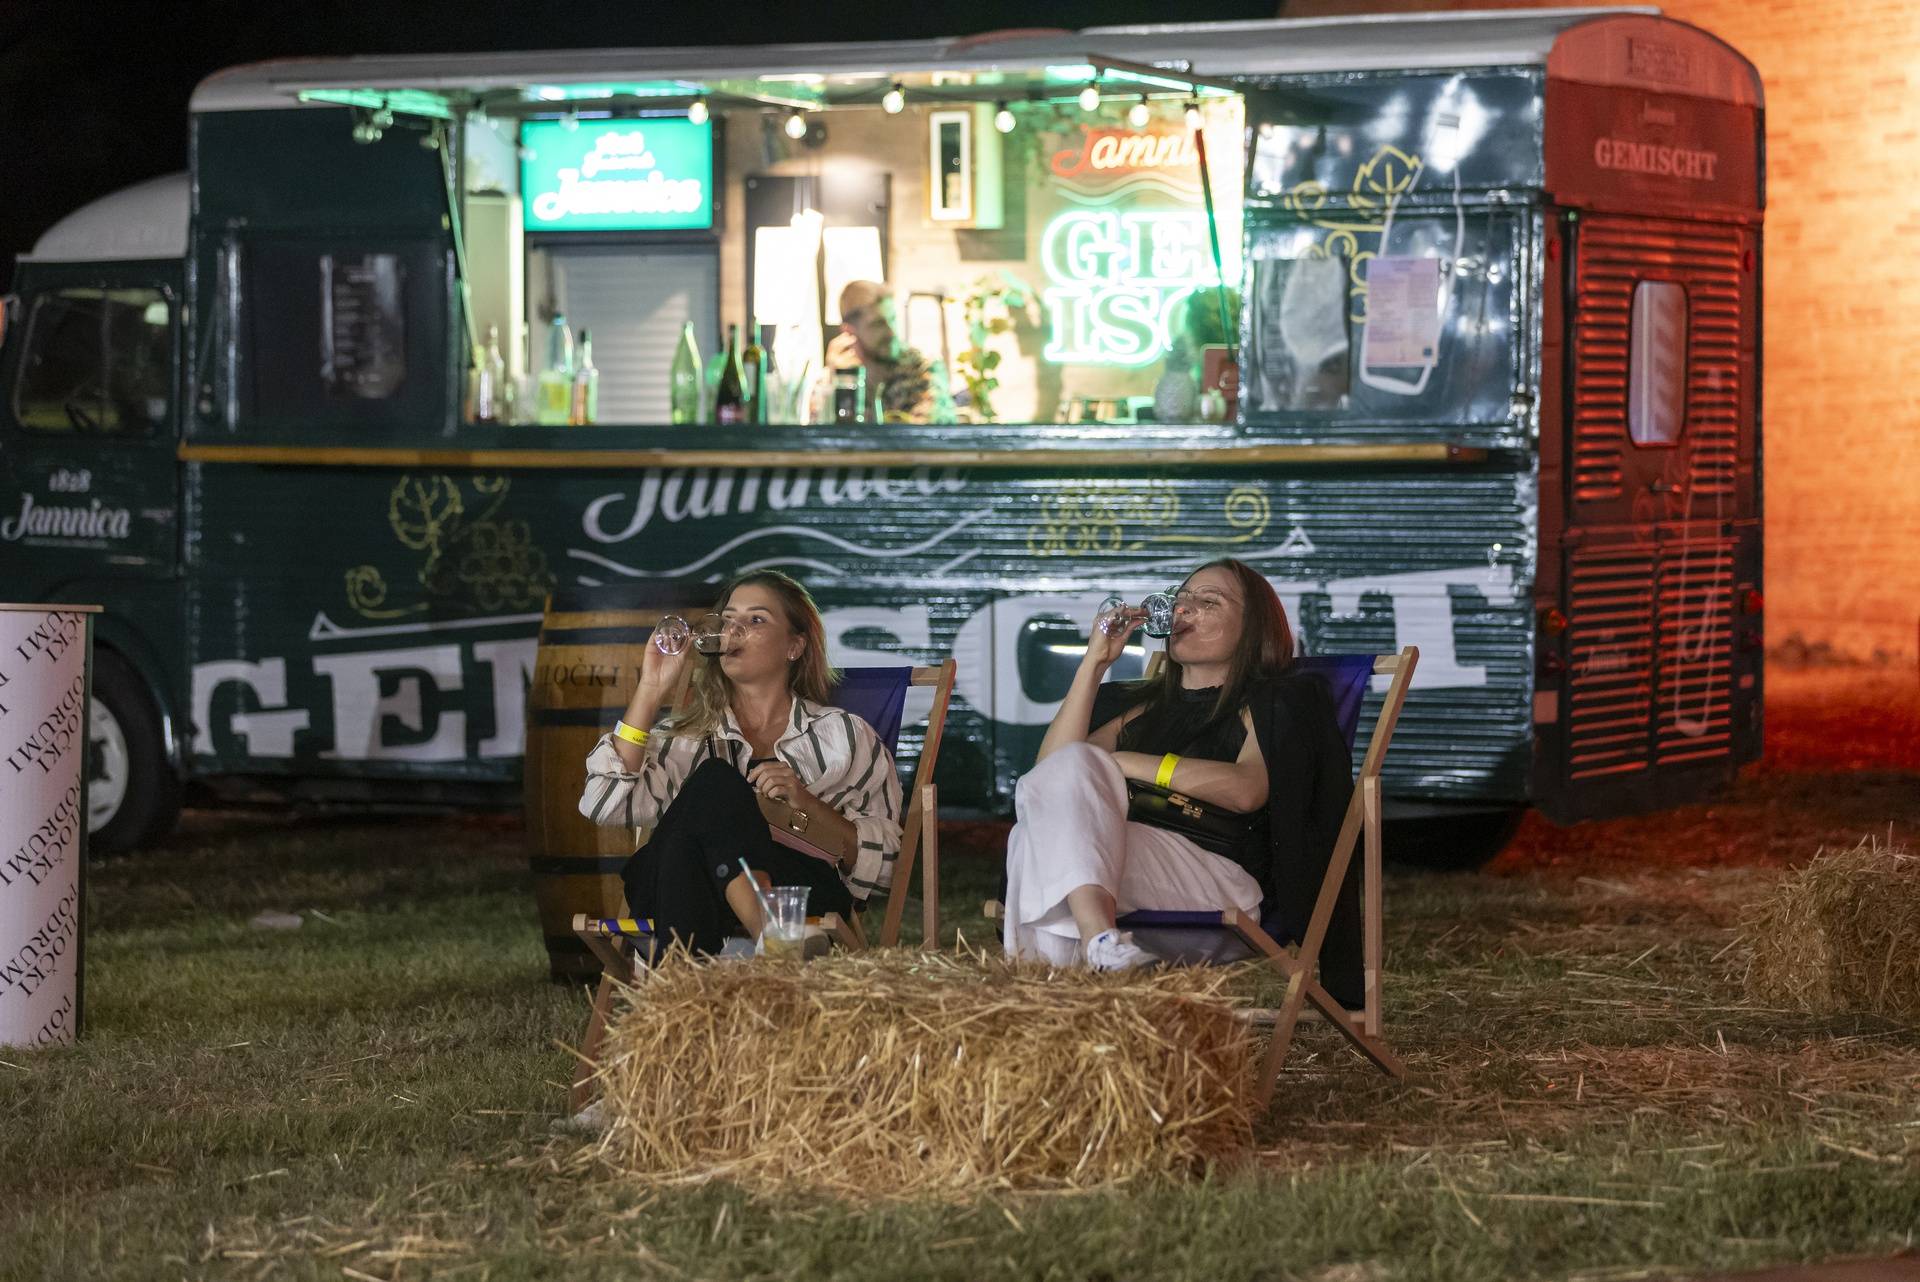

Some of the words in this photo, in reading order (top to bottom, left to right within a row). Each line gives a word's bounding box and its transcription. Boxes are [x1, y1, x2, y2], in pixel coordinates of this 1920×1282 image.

[1594, 137, 1718, 181] GEMISCHT
[1, 492, 131, 541] Jamnica
[7, 675, 84, 773] ODRUMI
[0, 883, 77, 997] PODRUM
